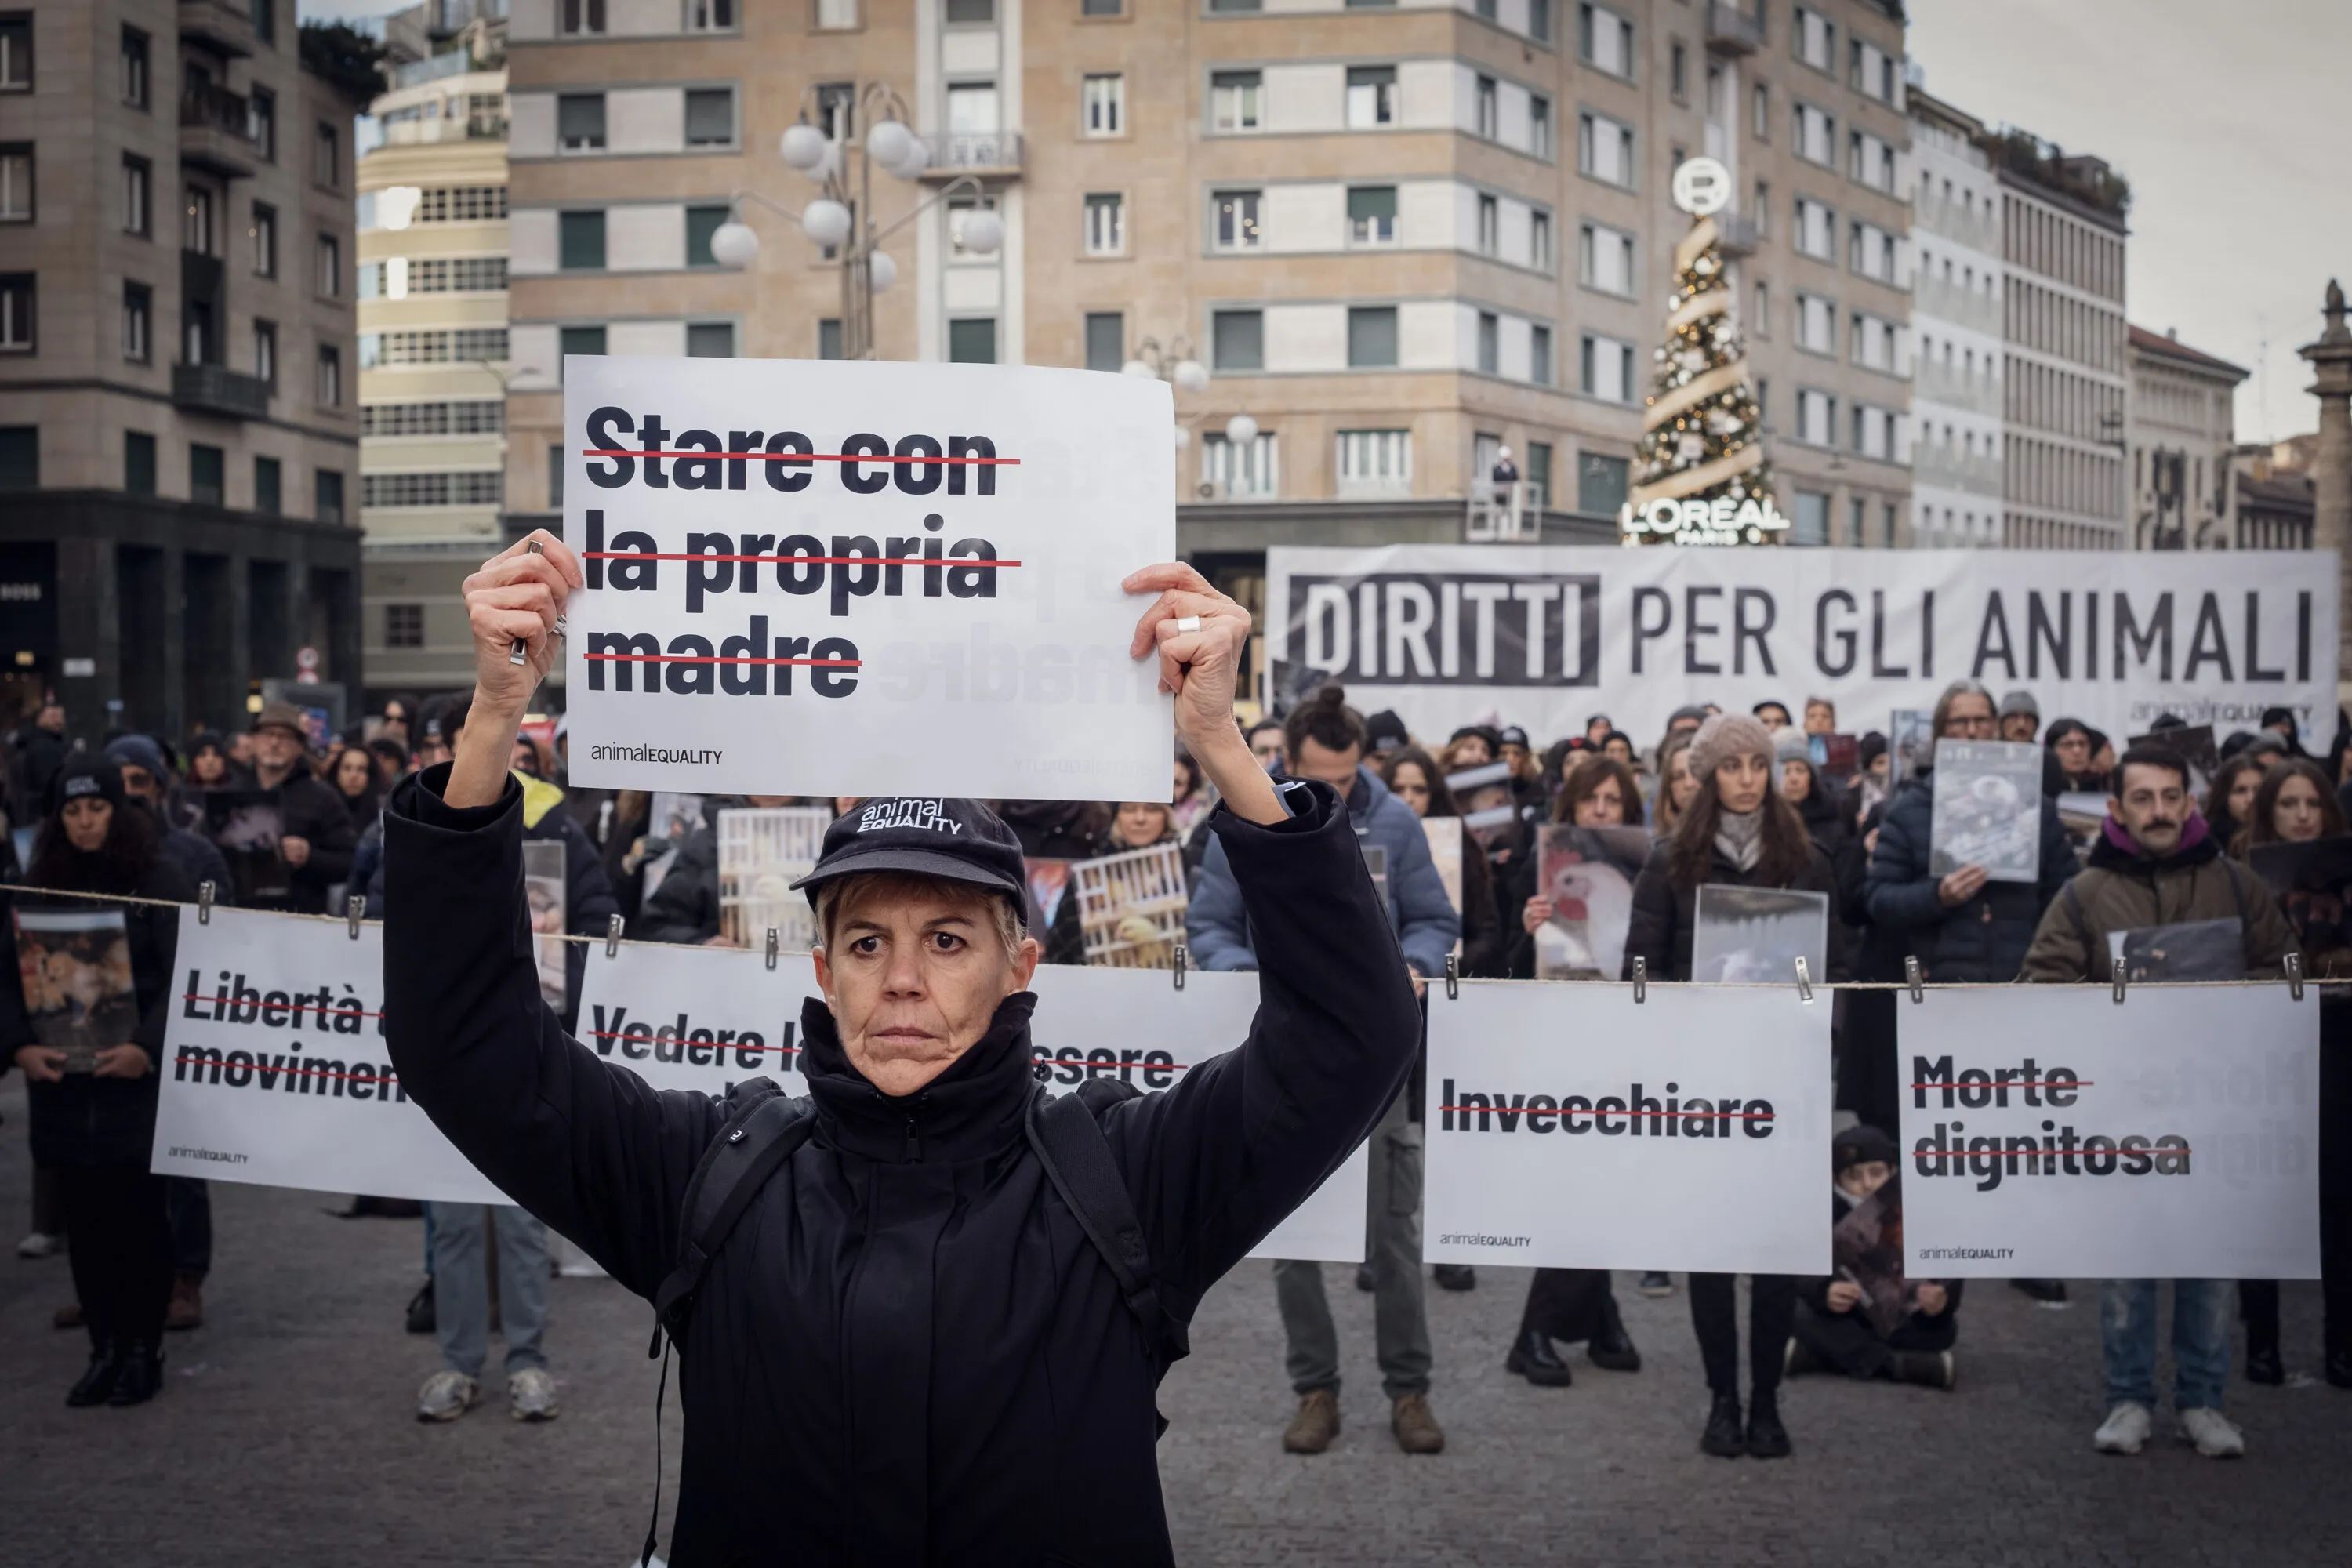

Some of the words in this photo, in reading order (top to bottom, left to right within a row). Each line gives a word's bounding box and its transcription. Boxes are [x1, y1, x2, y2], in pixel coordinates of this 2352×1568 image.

[586, 406, 814, 492] Stare
[840, 433, 996, 496] con
[586, 509, 658, 592] la
[685, 513, 997, 617] propria
[587, 615, 859, 699] madre
[1304, 581, 1582, 679] DIRITTI
[1631, 586, 1777, 677] PER
[1813, 588, 1936, 681] GLI
[1970, 589, 2313, 683] ANIMALI
[590, 741, 723, 765] animalEQUALITY
[857, 815, 962, 835] EQUALITY
[861, 797, 944, 822] animal
[183, 968, 364, 1036] Libertà
[592, 1004, 765, 1069] Vedere
[780, 1021, 803, 1073] l
[1441, 1078, 1774, 1139] Invecchiare
[1912, 1055, 2078, 1109] Morte
[1915, 1120, 2191, 1192] dignitosa
[1439, 1231, 1532, 1247] animalEQUALITY
[1919, 1246, 2015, 1260] animalEQUALITY
